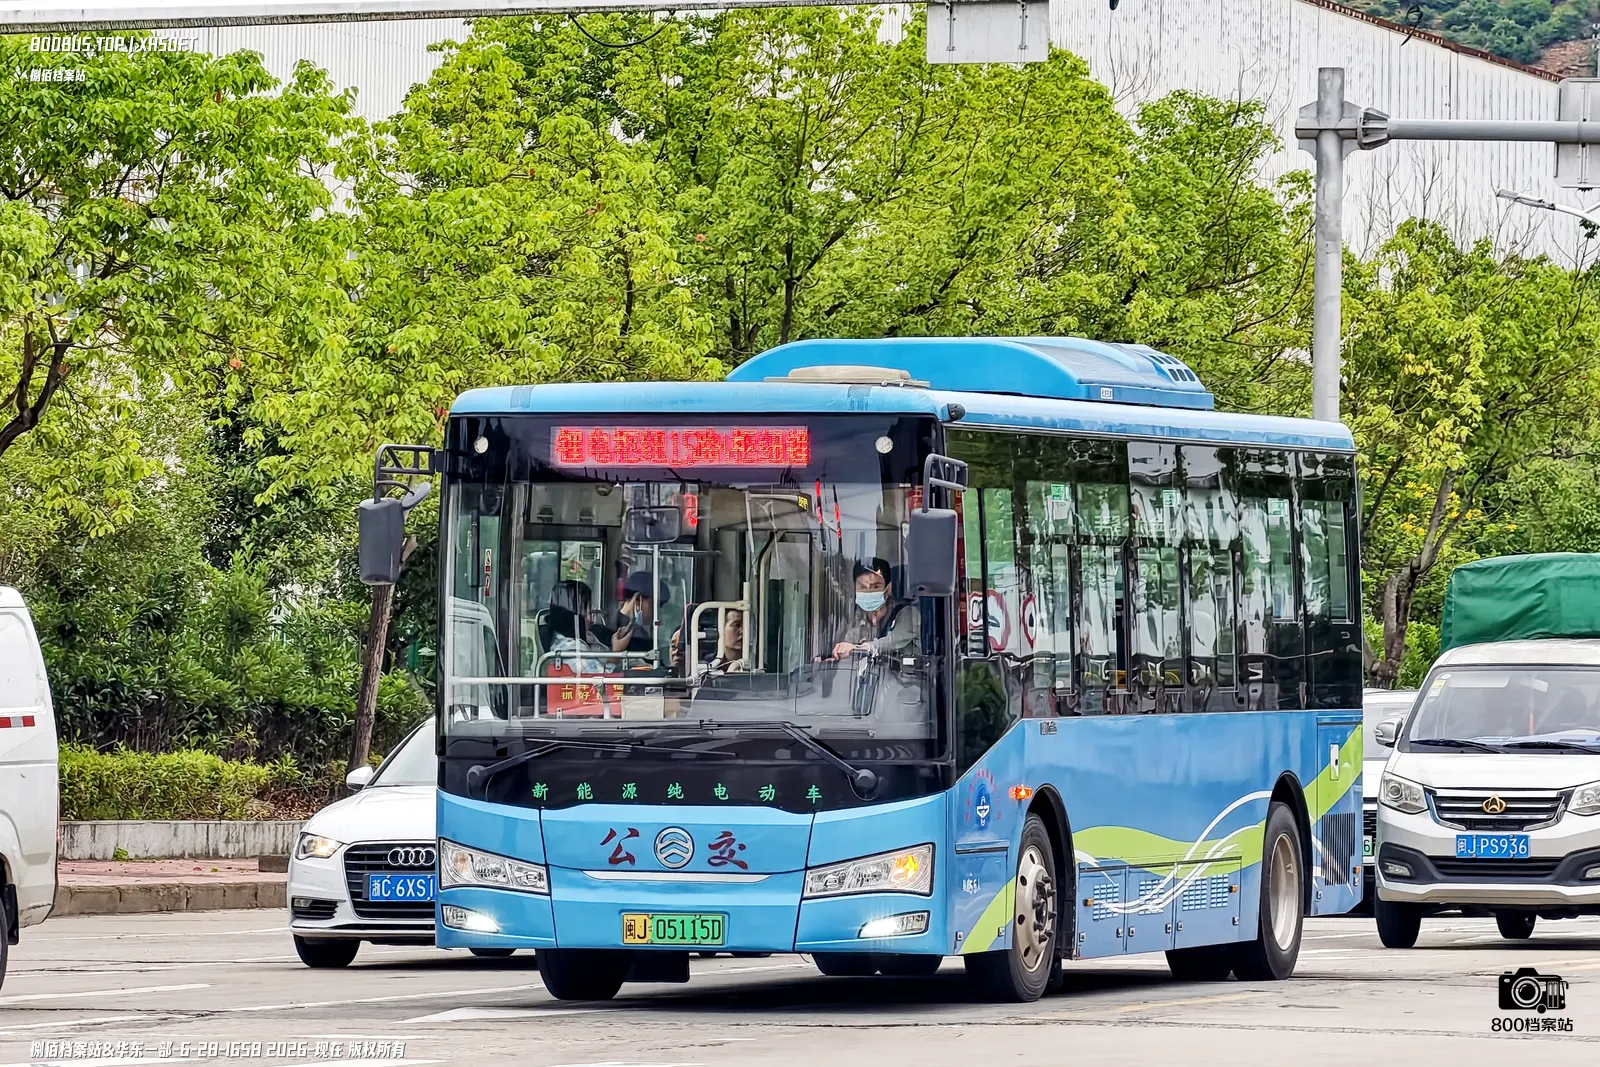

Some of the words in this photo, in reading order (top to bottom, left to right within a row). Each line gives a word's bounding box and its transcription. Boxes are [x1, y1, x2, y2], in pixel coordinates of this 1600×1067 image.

[532, 782, 823, 804] 新能源纯电动车
